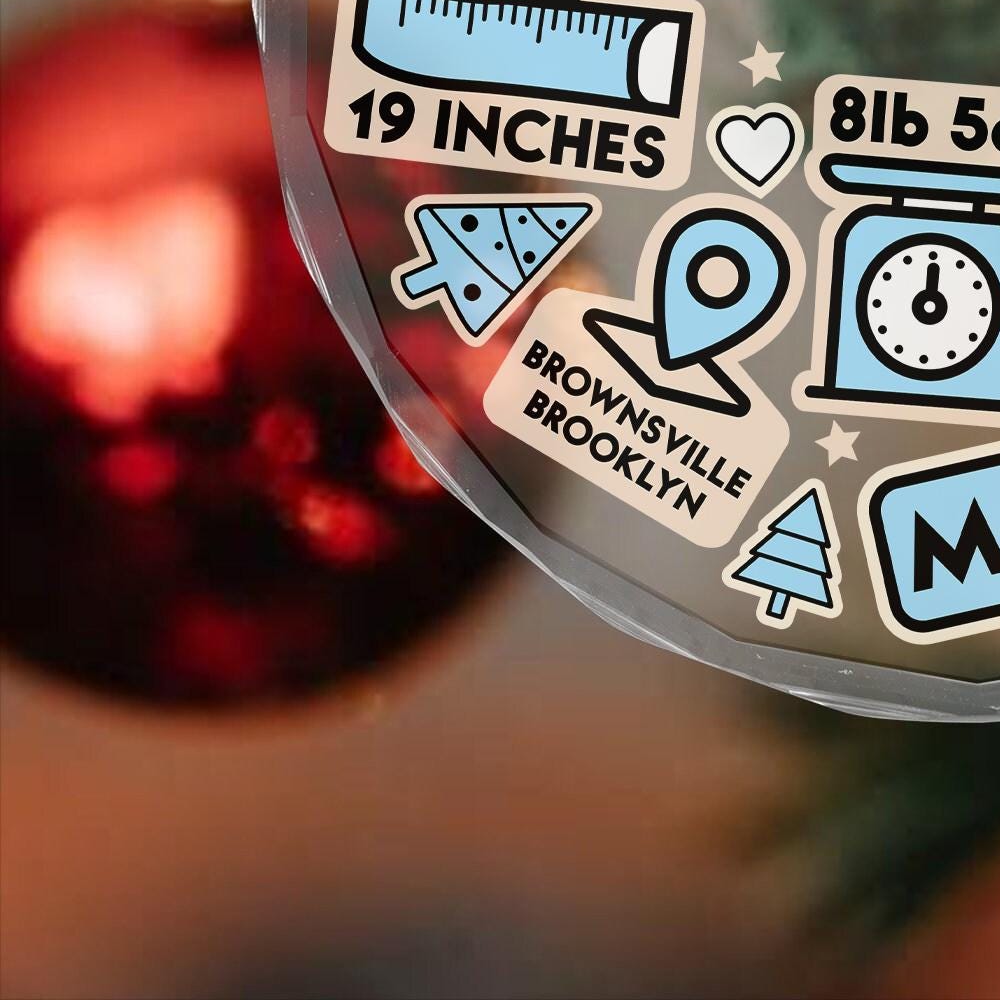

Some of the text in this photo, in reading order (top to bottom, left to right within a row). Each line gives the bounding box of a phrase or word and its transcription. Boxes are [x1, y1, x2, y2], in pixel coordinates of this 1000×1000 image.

[348, 88, 666, 179] 19 INCHES
[830, 86, 929, 147] 8lb
[522, 339, 753, 499] BROWNSVILLE
[523, 389, 708, 520] BROOKLYN
